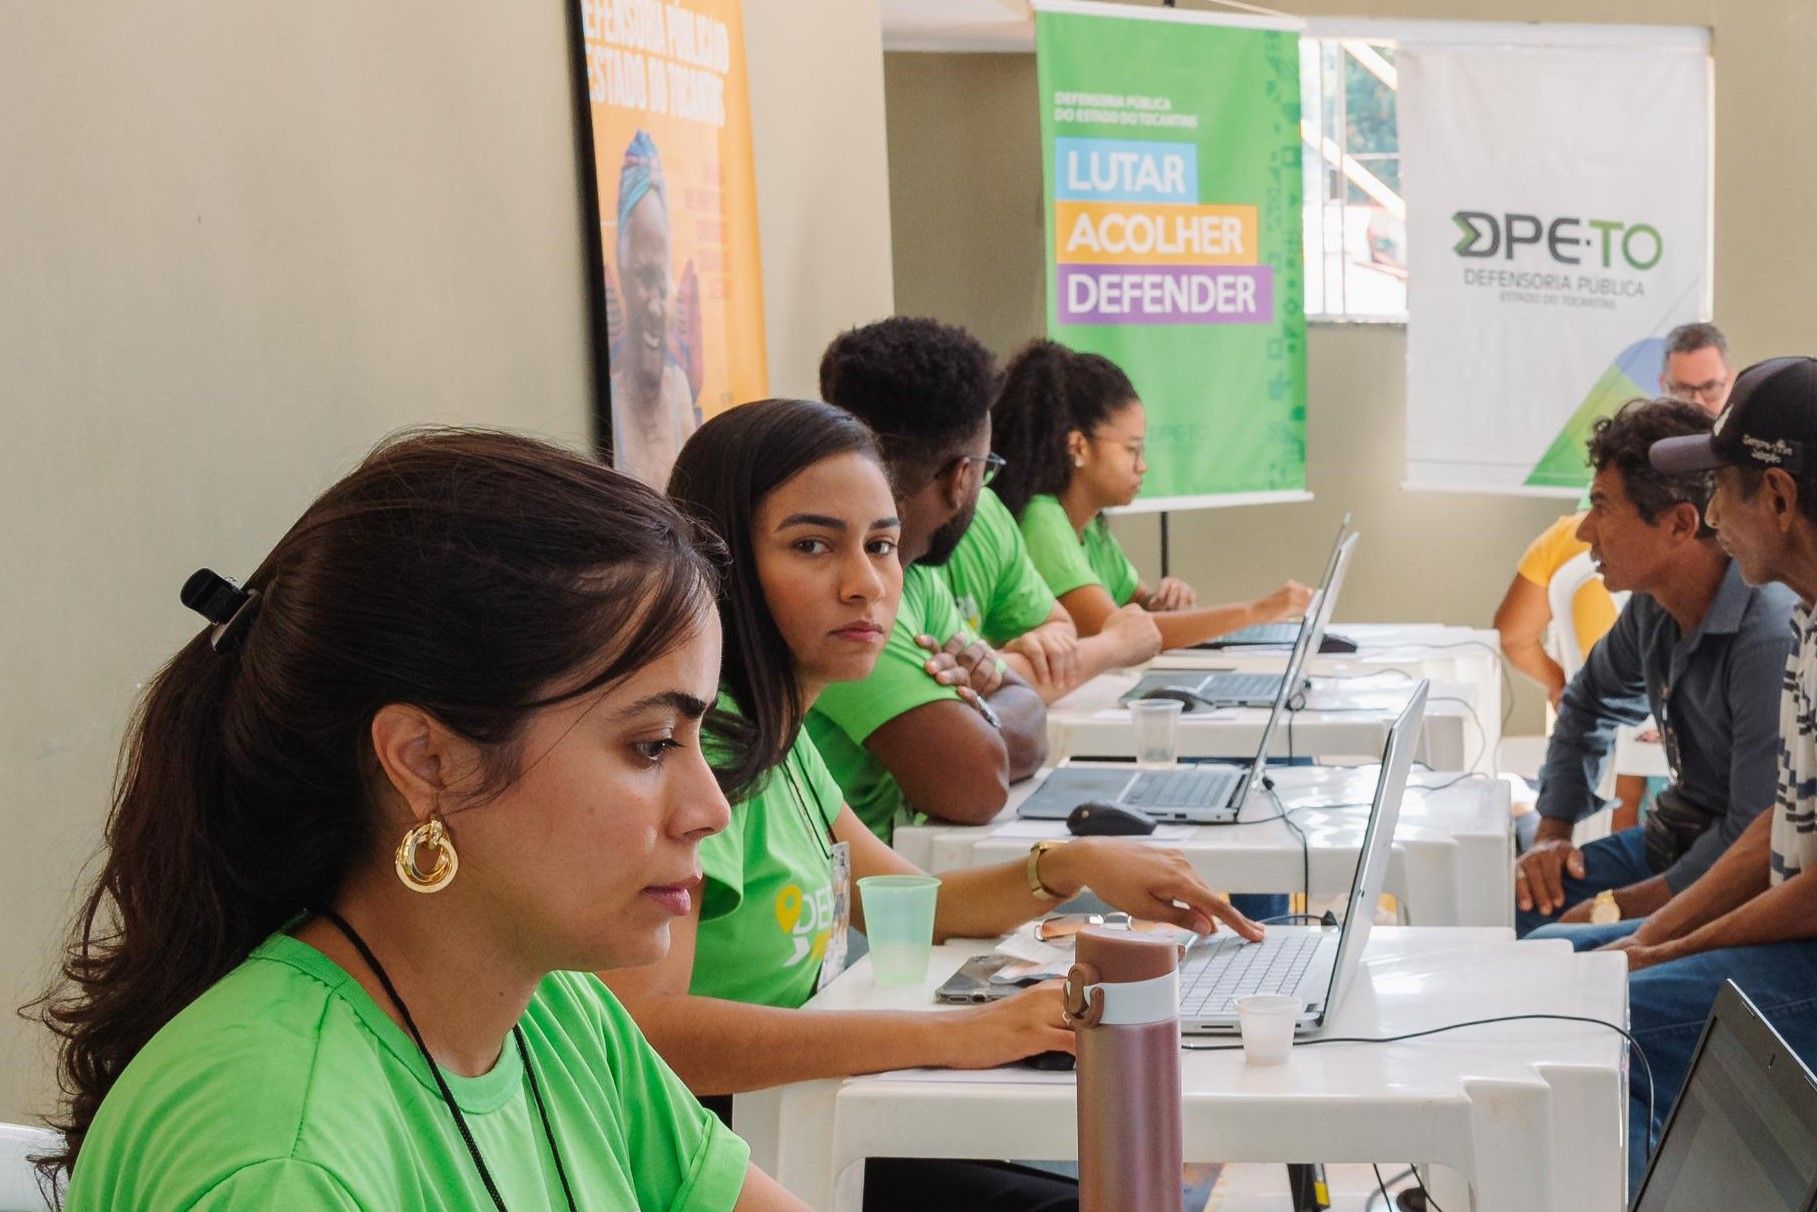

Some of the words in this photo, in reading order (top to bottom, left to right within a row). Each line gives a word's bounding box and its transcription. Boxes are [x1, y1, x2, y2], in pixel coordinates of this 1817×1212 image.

[1068, 150, 1186, 194] LUTAR
[1066, 212, 1245, 255] ACOLHER
[1067, 273, 1257, 314] DEFENDER
[1463, 268, 1571, 291] DEFENSORIA
[1577, 274, 1645, 297] PÚBLICA
